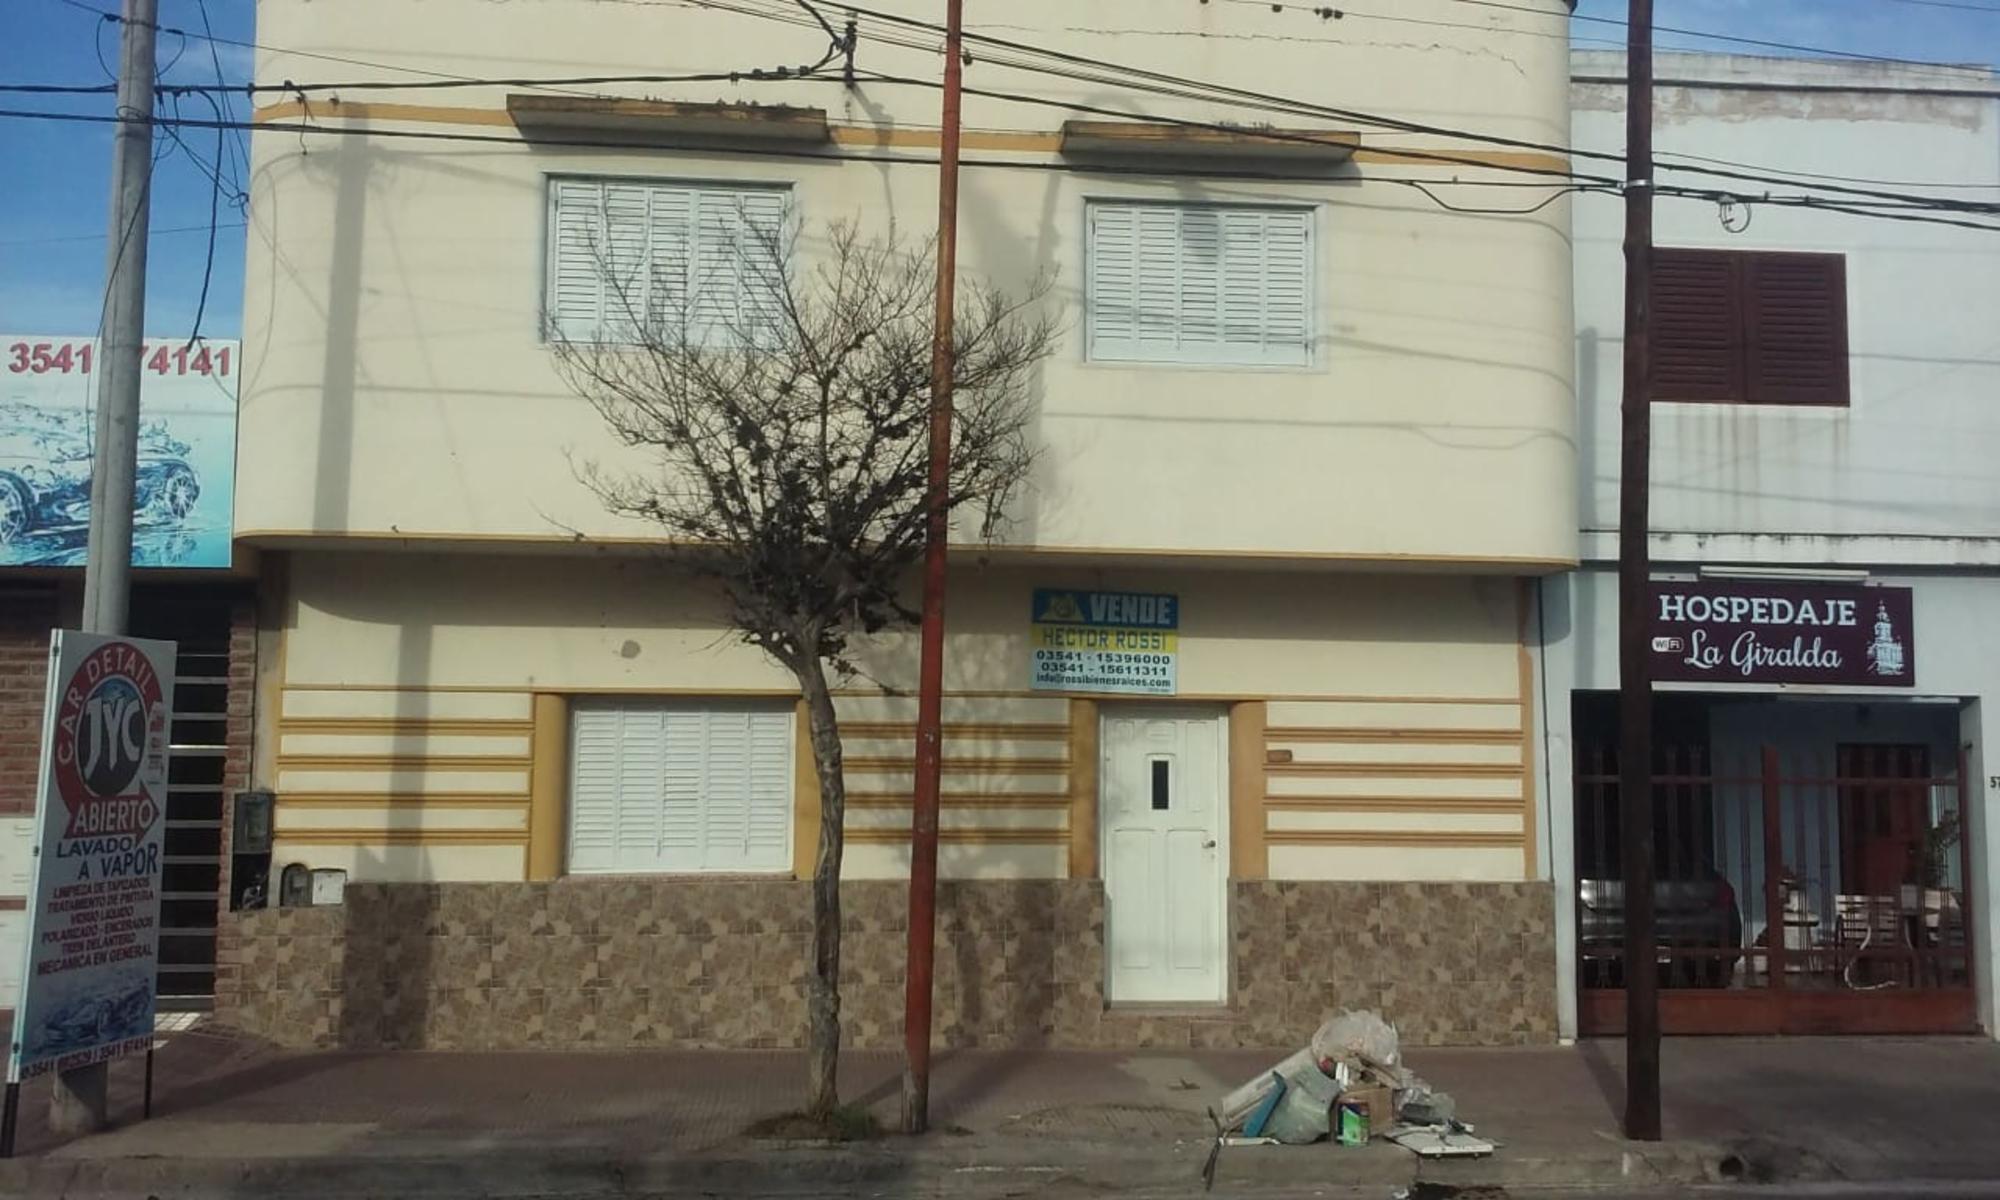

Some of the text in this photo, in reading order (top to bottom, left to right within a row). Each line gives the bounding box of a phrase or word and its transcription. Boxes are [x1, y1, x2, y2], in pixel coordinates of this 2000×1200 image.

[8, 343, 91, 374] 3541
[1090, 594, 1171, 625] VENDE
[1658, 595, 1857, 626] HOSPEDAJE
[1043, 627, 1167, 650] HECTOR ROSSI
[1684, 629, 1843, 676] La Giralda
[1036, 650, 1082, 662] 03541
[1041, 661, 1084, 673] 03541
[58, 647, 152, 765] CAR DETAIL
[83, 696, 141, 780] JYC
[73, 798, 154, 834] ABIERTO
[56, 836, 133, 858] LAVADO
[78, 842, 158, 880] A VAPOR
[110, 944, 153, 962] GENERAL
